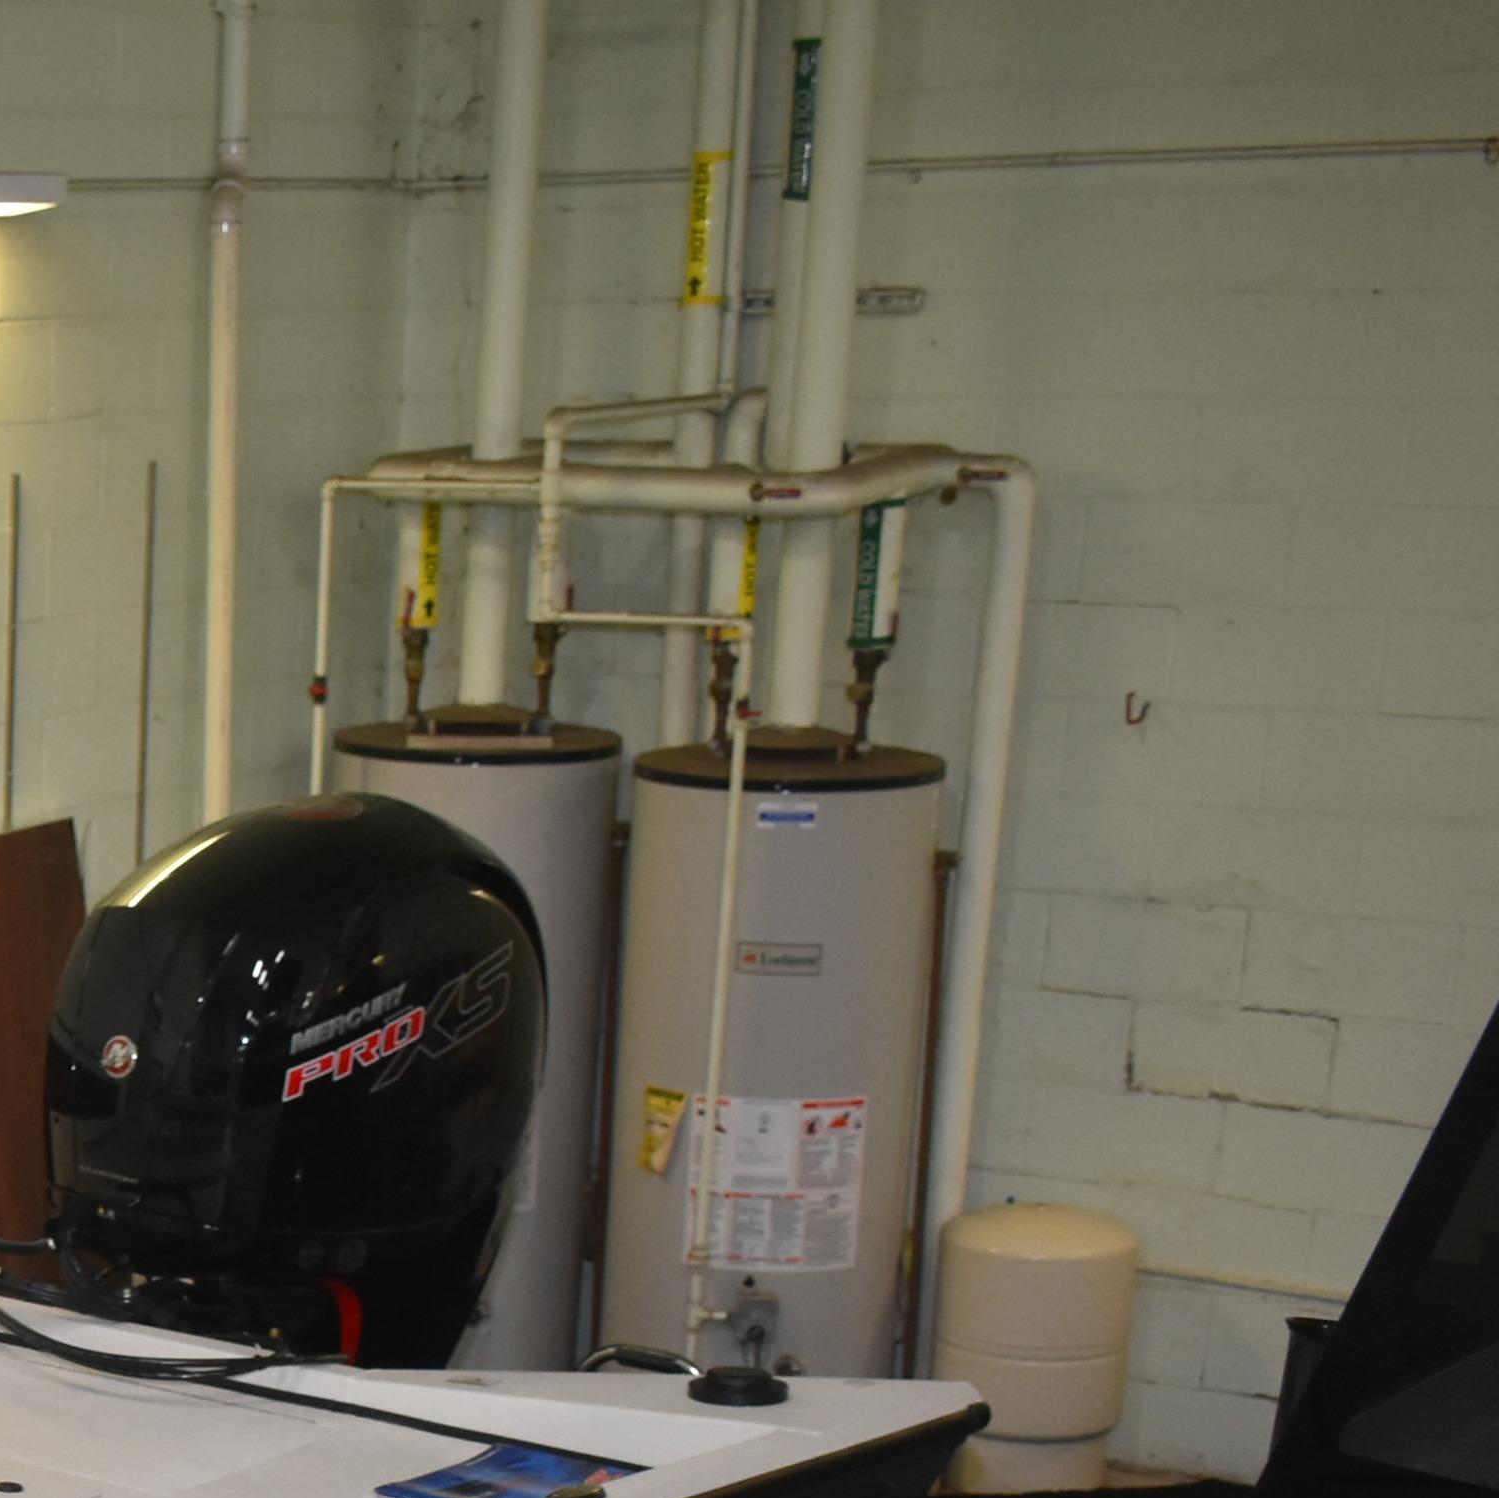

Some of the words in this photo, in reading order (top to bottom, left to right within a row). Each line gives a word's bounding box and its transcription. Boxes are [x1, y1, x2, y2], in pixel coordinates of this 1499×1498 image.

[692, 162, 709, 222] WATER
[690, 228, 706, 263] HOT
[859, 540, 876, 585] COLD
[282, 1006, 427, 1103] PRO
[369, 941, 514, 1093] XS
[290, 982, 408, 1055] MERCURY
